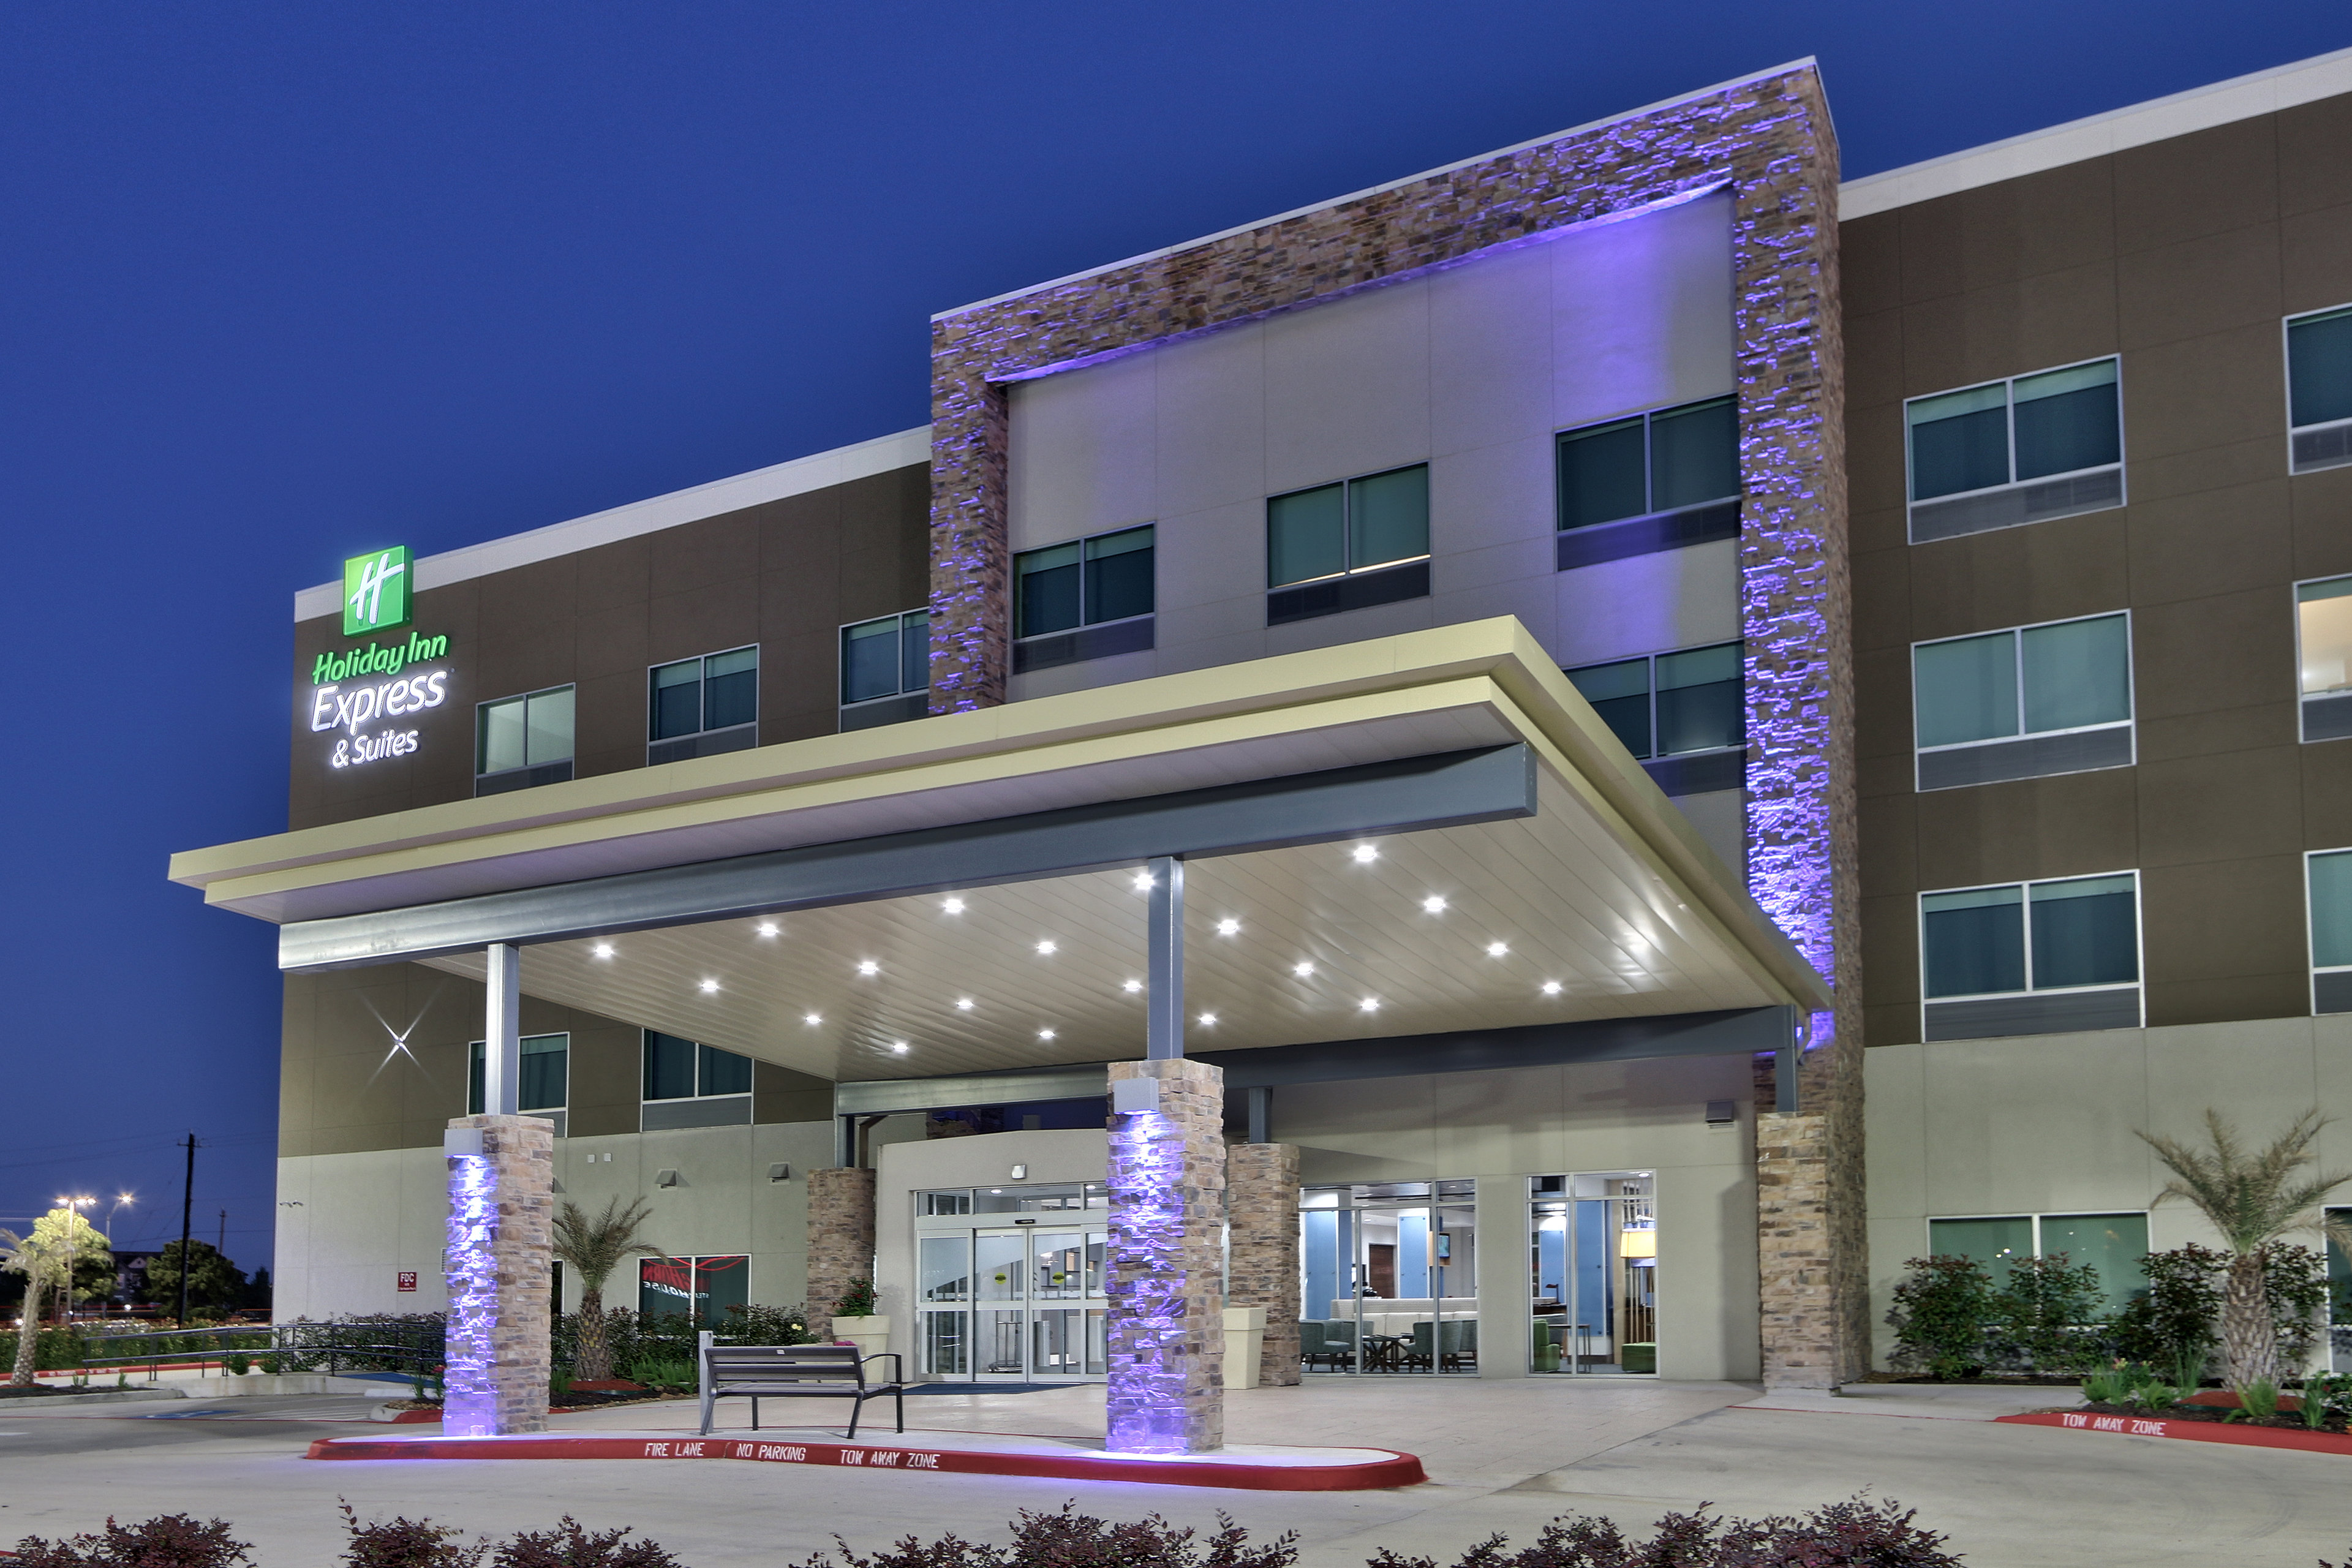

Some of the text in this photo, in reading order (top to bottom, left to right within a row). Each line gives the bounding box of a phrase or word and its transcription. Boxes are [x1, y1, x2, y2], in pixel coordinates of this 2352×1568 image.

[349, 552, 405, 625] H
[312, 631, 449, 685] Holiday Inn
[311, 669, 447, 736] Express
[331, 728, 420, 769] & Suites
[400, 1273, 415, 1283] FDC
[2063, 1414, 2166, 1436] TOW AWAY ZONE
[645, 1442, 705, 1457] FIRE LANE
[737, 1444, 807, 1461] NO PARKING
[840, 1449, 940, 1468] TOW AWAY ZONE
